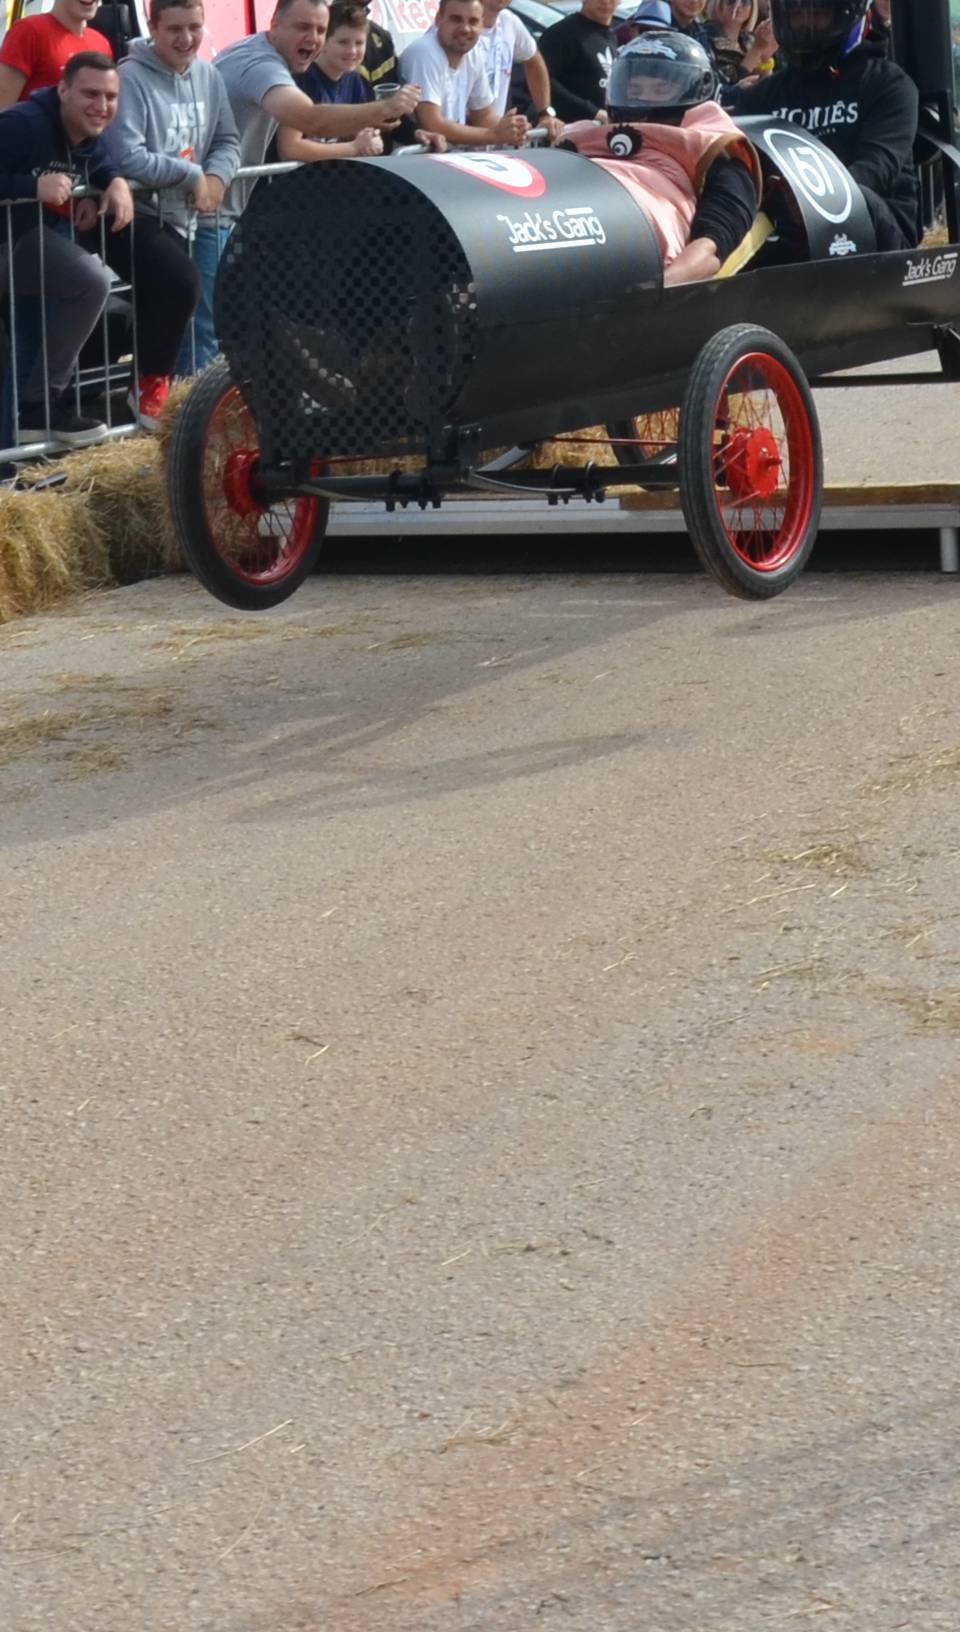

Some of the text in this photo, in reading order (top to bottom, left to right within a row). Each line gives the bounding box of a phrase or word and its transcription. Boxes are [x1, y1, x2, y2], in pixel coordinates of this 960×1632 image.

[788, 147, 834, 197] 67
[496, 208, 606, 244] Jack's Gang
[904, 253, 959, 281] Jack's Gang
